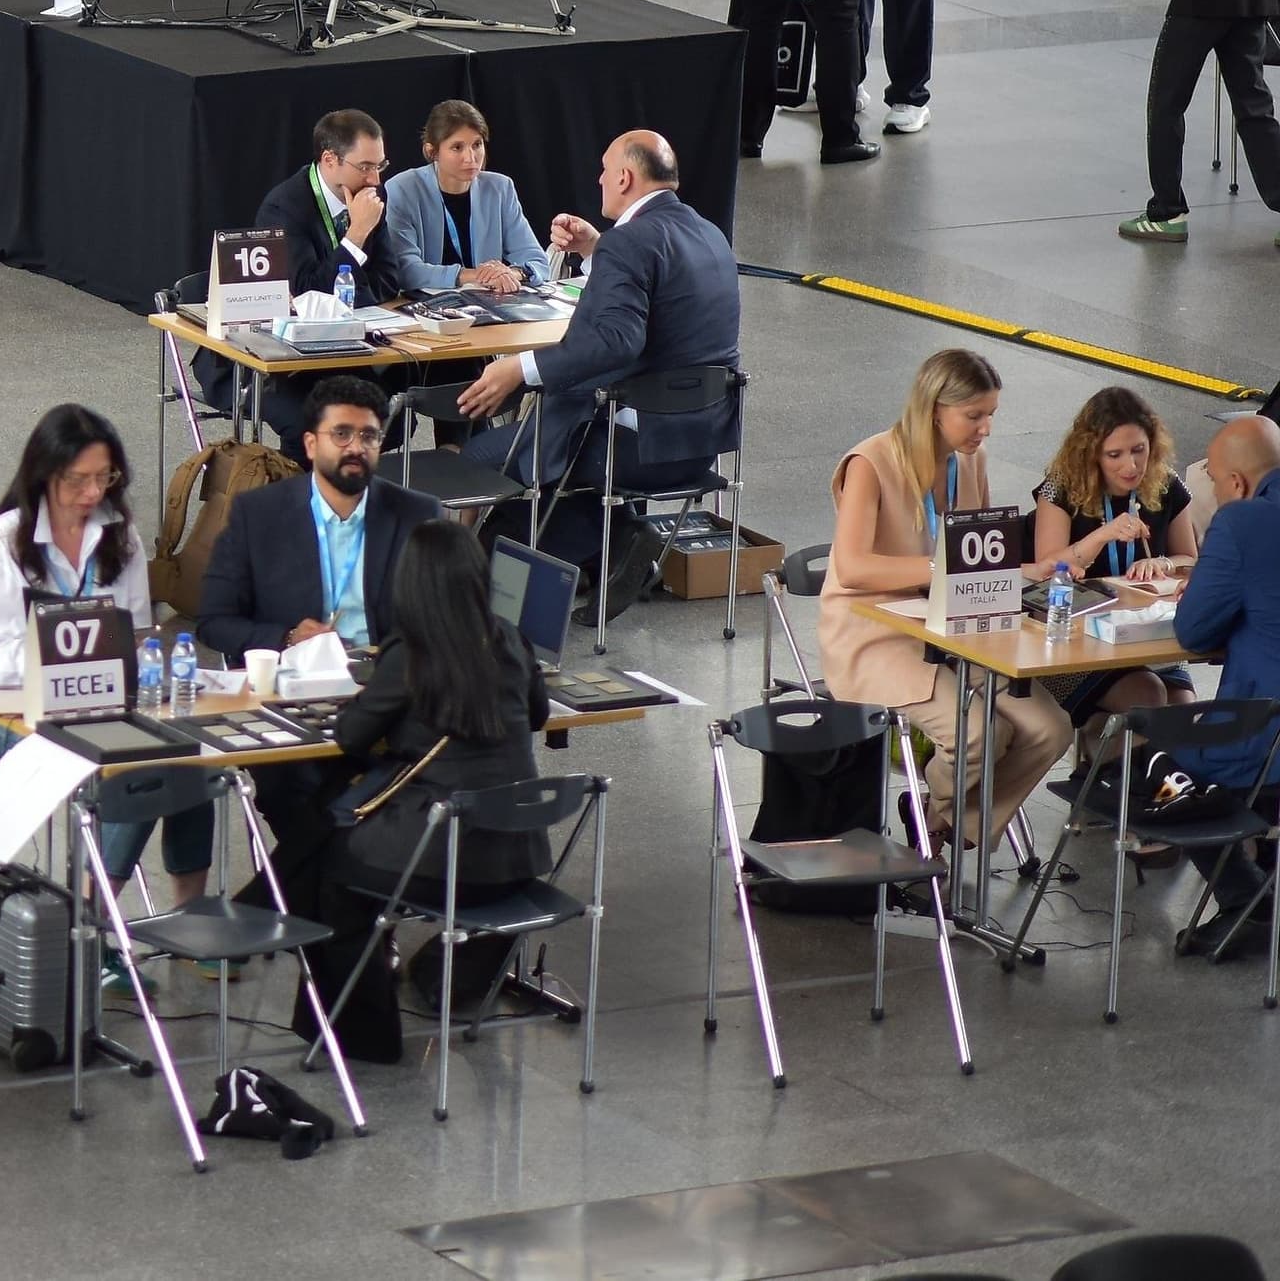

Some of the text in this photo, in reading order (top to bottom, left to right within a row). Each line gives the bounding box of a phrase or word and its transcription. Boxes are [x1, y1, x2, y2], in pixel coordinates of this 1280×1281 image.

[234, 246, 270, 277] 16
[226, 295, 253, 303] SMART
[961, 531, 1005, 566] 06
[955, 579, 1013, 596] NATUZZI
[969, 594, 998, 605] ITALIA
[55, 618, 100, 657] 07
[51, 674, 103, 698] TECE
